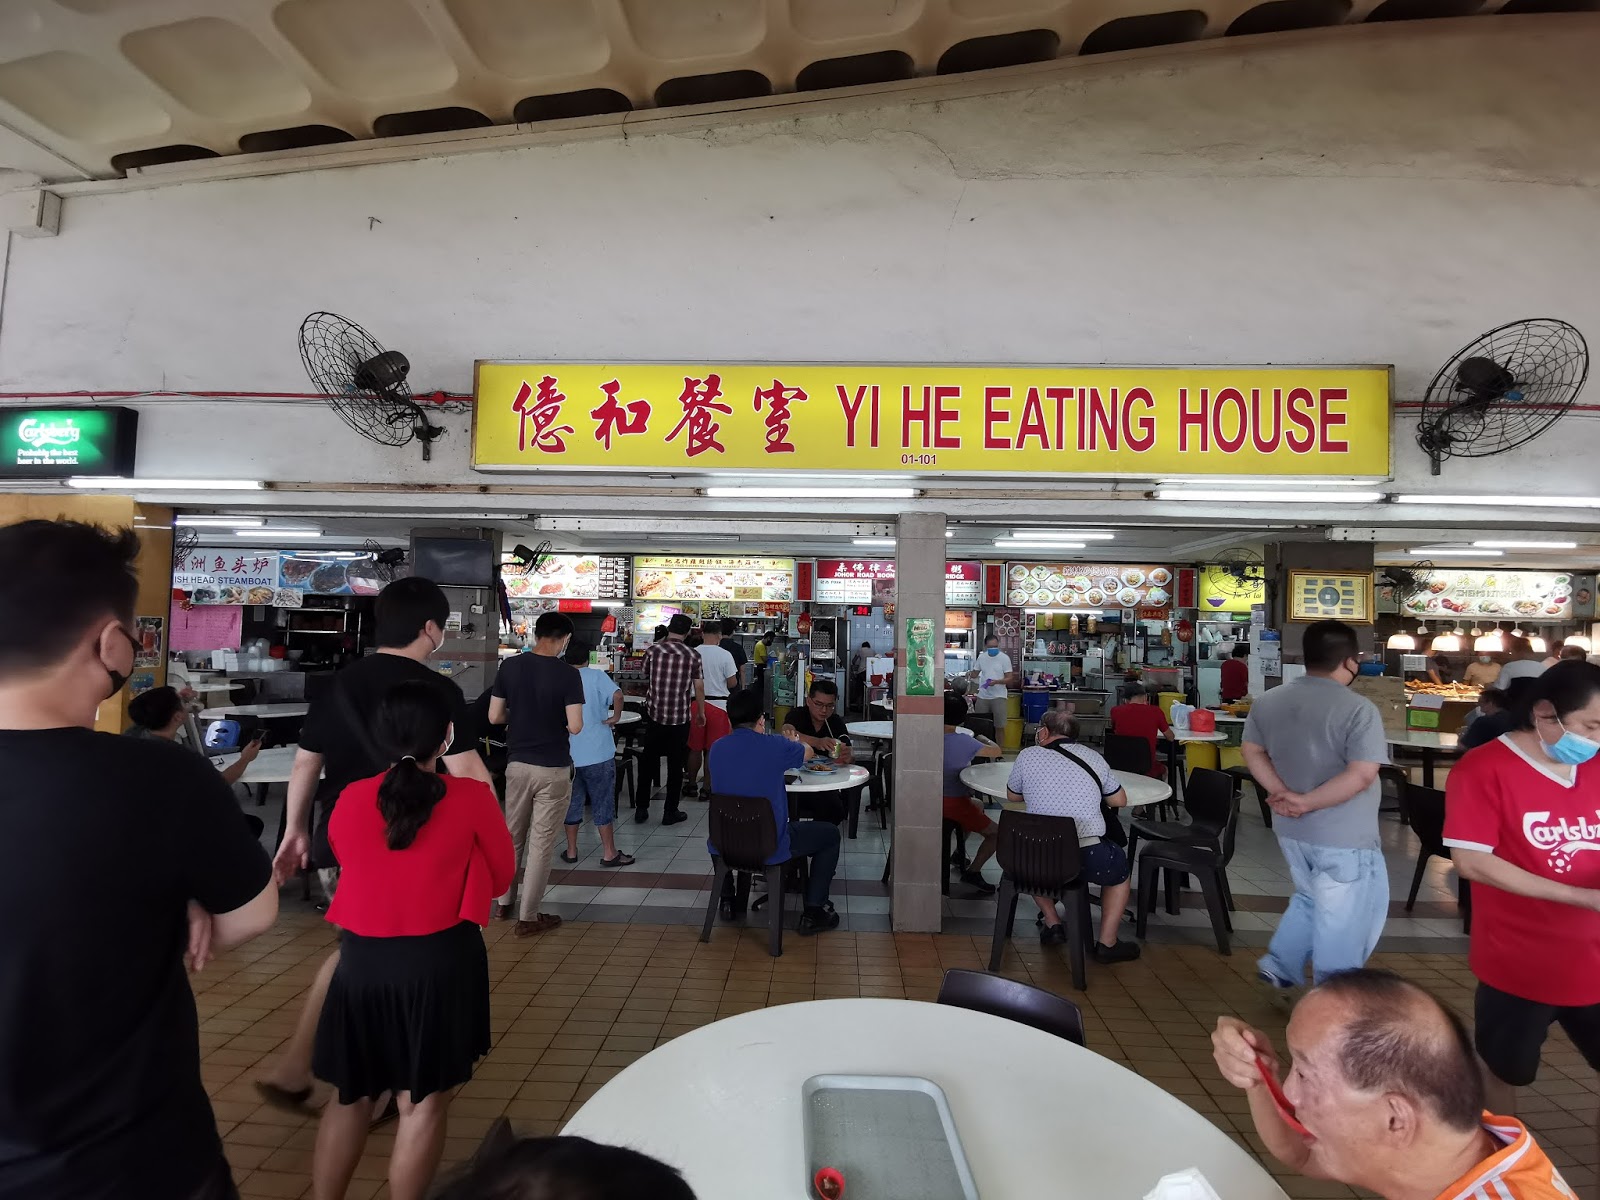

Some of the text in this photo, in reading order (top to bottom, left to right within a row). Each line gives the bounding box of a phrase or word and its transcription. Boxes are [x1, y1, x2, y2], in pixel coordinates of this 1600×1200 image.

[836, 384, 1349, 454] YI HE EATING HOUSE
[18, 418, 80, 448] Carlsberg
[17, 457, 33, 465] beer
[43, 457, 55, 465] the
[901, 454, 937, 466] 01-101
[174, 576, 273, 586] ISH HEAD STEAMBOAT
